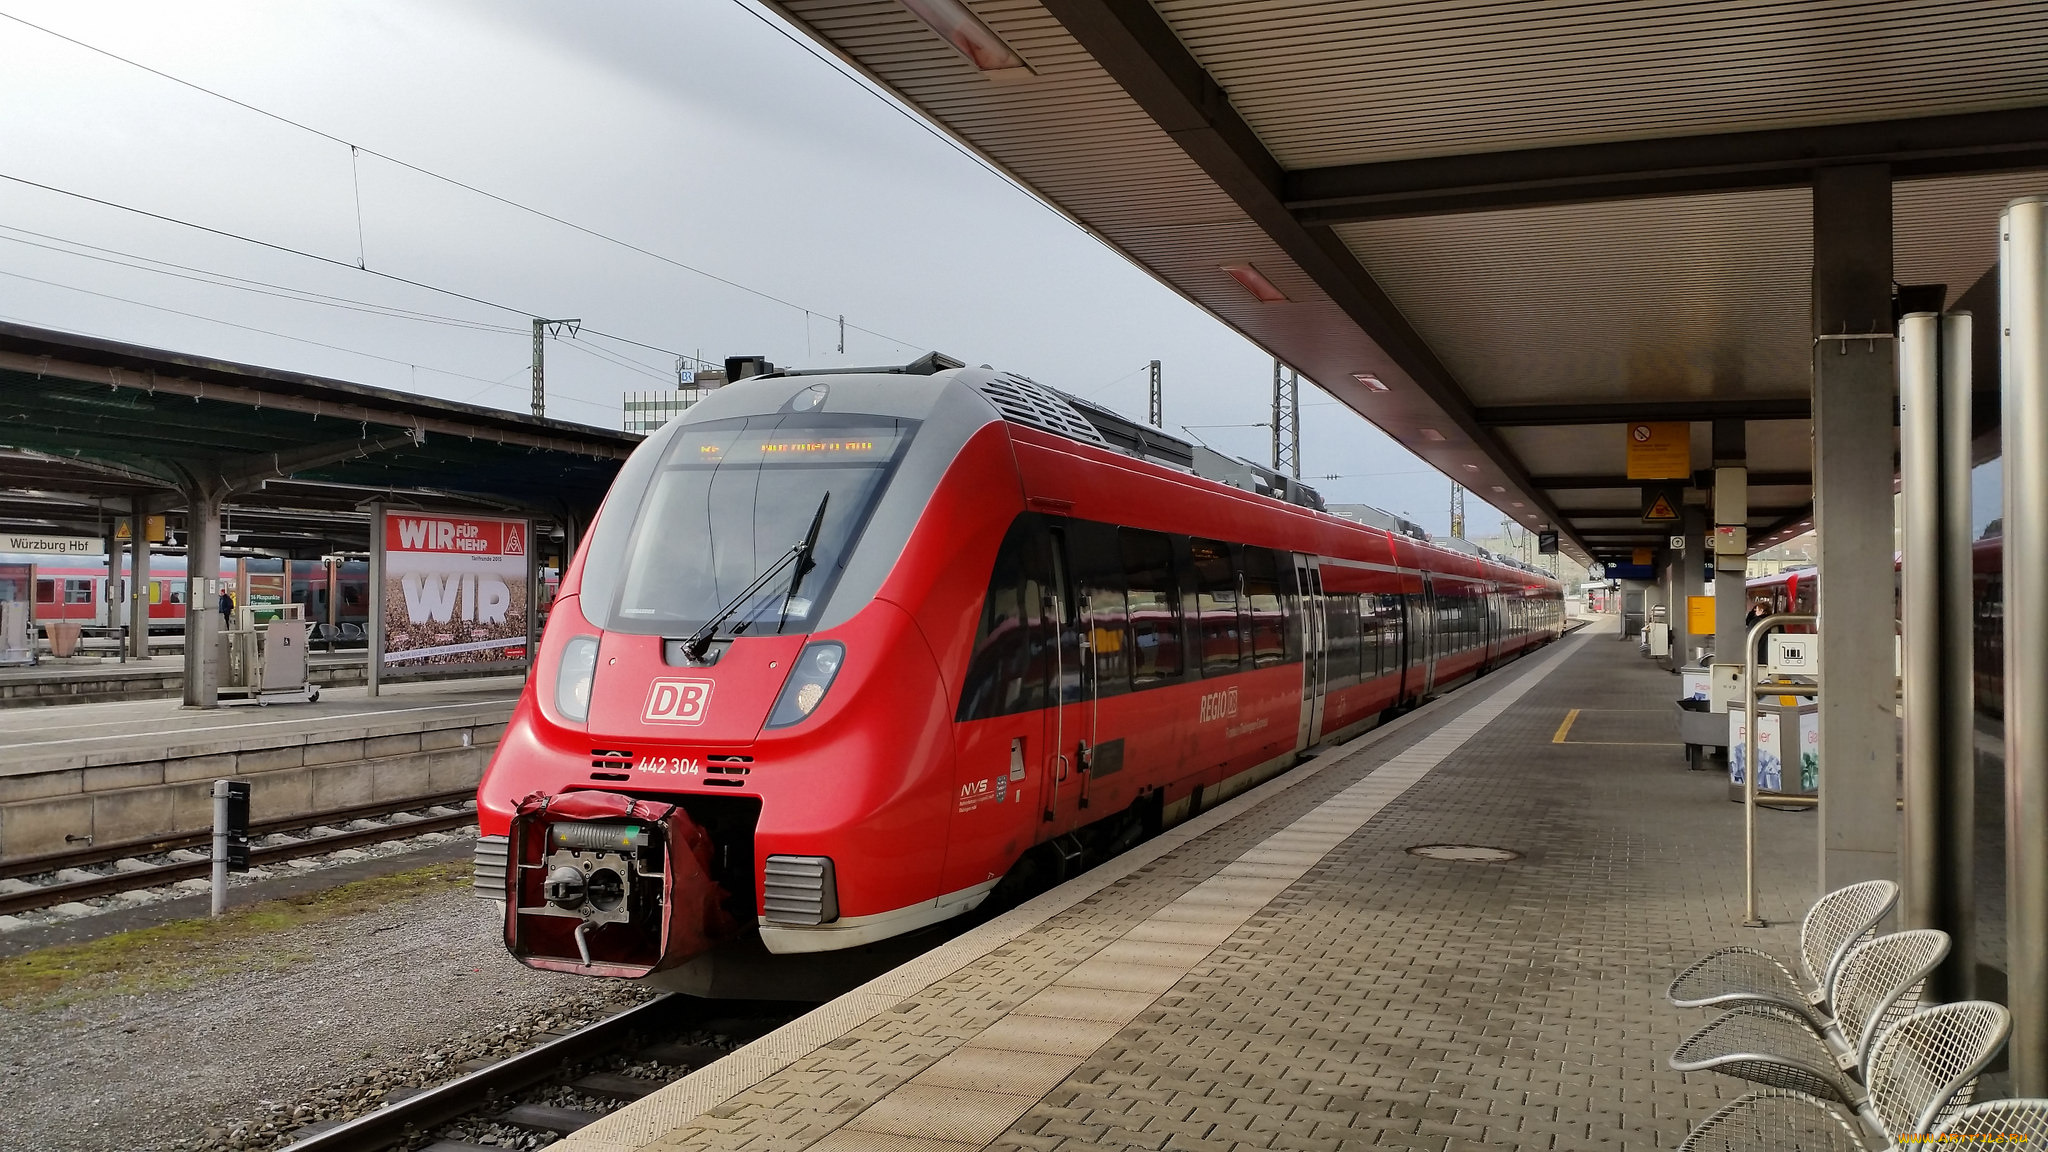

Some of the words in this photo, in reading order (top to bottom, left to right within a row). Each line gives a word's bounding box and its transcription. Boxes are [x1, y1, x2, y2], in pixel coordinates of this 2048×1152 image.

[682, 371, 693, 381] BR
[398, 518, 456, 550] WIR
[456, 523, 479, 538] FÜR
[10, 538, 66, 553] Würzburg
[69, 540, 89, 551] Hbf
[456, 538, 488, 552] MEHR
[401, 571, 511, 625] WIR
[649, 683, 706, 718] DB
[1200, 690, 1228, 724] REGIO
[638, 756, 667, 774] 442
[670, 757, 699, 775] 304
[961, 779, 988, 797] NVS
